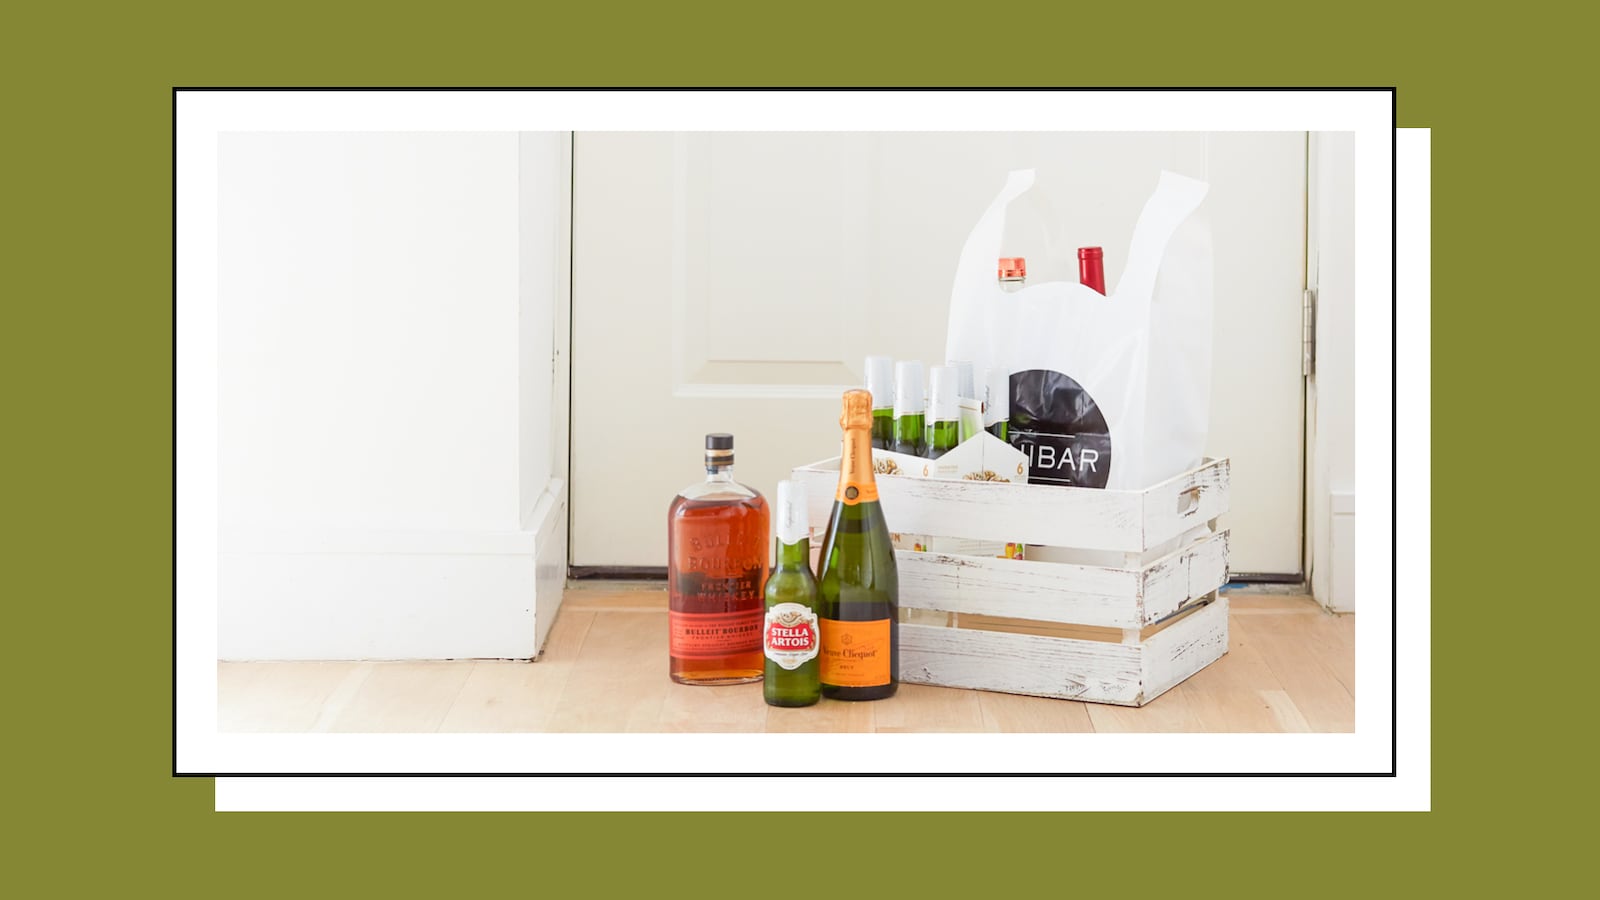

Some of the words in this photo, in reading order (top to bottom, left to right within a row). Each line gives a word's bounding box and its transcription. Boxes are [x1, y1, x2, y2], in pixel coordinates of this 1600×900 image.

[922, 464, 929, 477] 6
[1016, 463, 1024, 475] 6
[685, 628, 719, 636] BULLEIT
[722, 624, 758, 635] BOURBON
[771, 627, 809, 638] STELLA
[771, 637, 809, 647] ARTOIS
